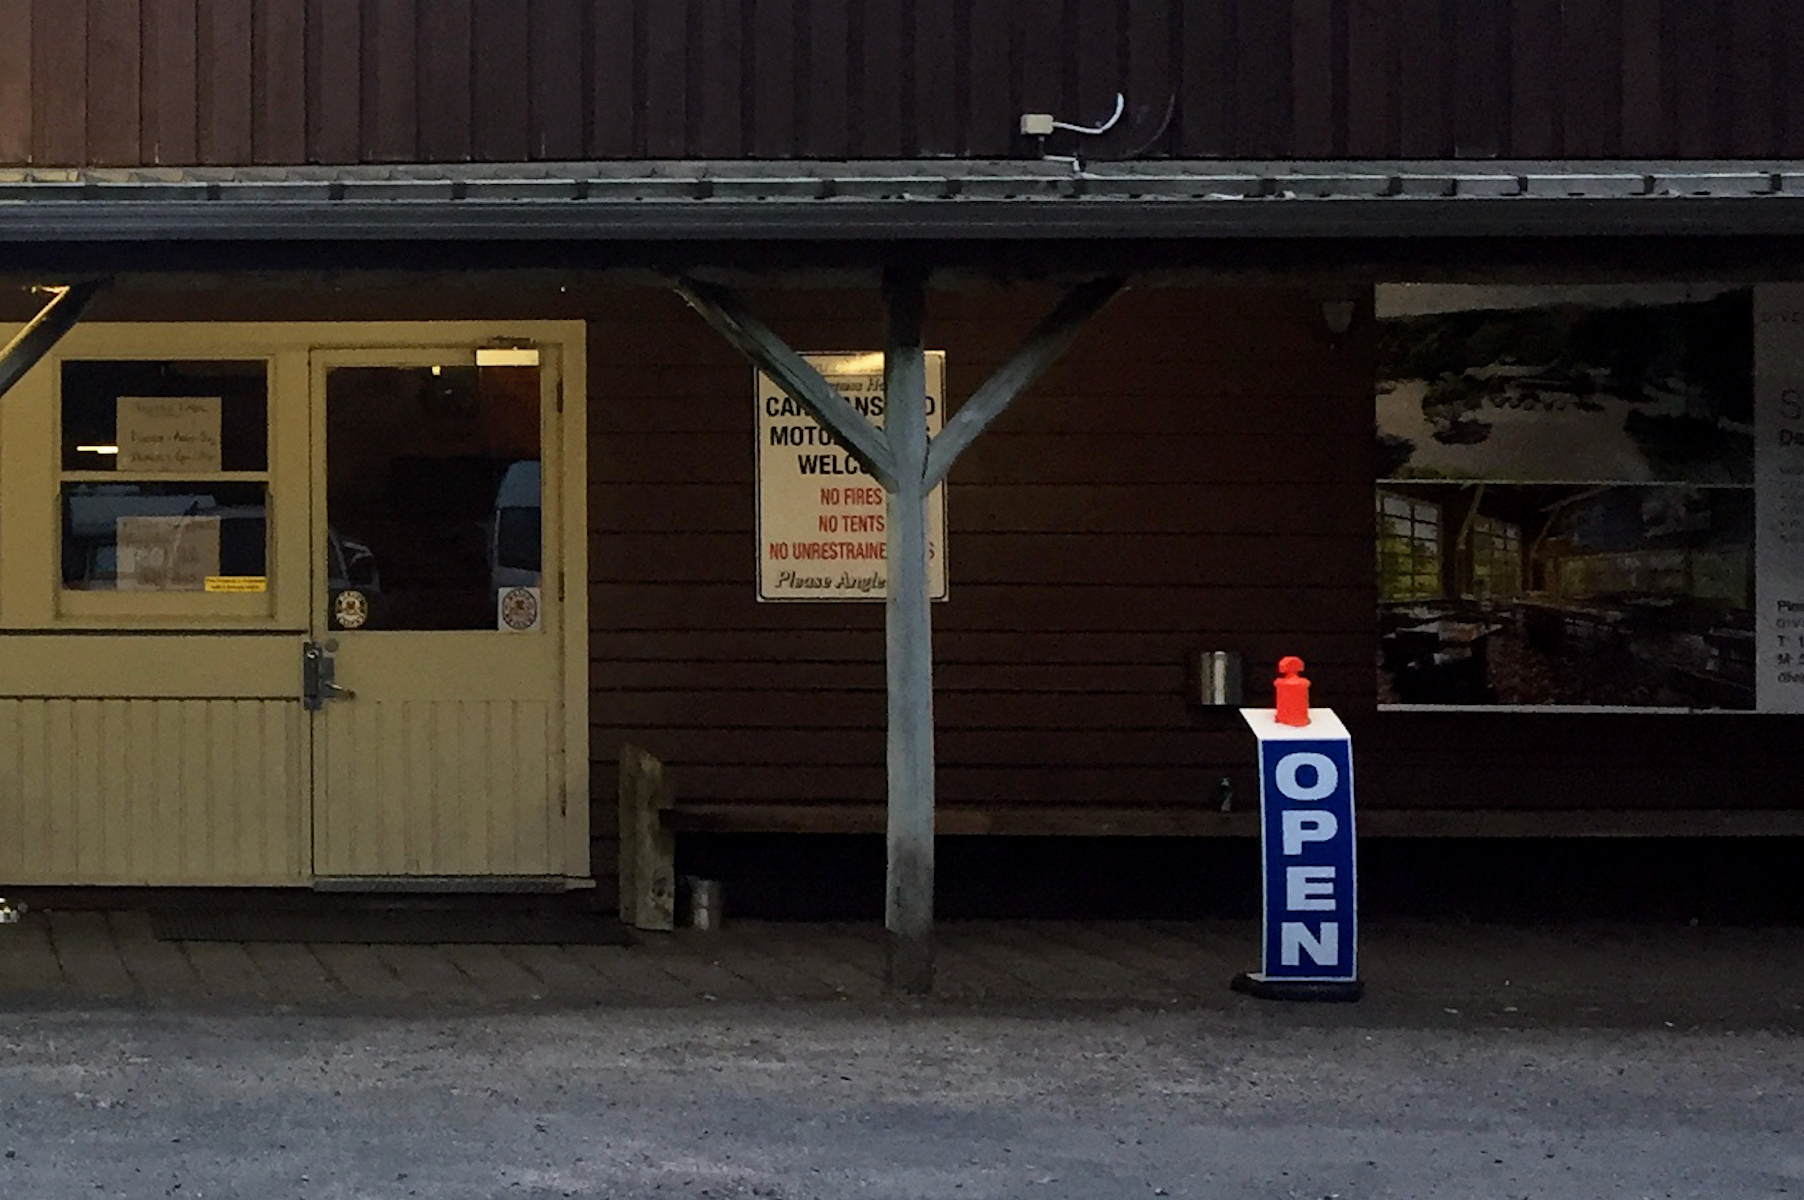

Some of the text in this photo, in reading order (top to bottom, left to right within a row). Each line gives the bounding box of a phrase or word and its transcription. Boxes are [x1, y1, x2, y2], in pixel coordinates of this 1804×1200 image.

[820, 488, 883, 505] NO FIRES
[818, 515, 885, 533] NO TENTS
[769, 542, 887, 560] NO UNRESTRAINE
[774, 568, 833, 590] Please
[1275, 752, 1339, 966] OPEN
